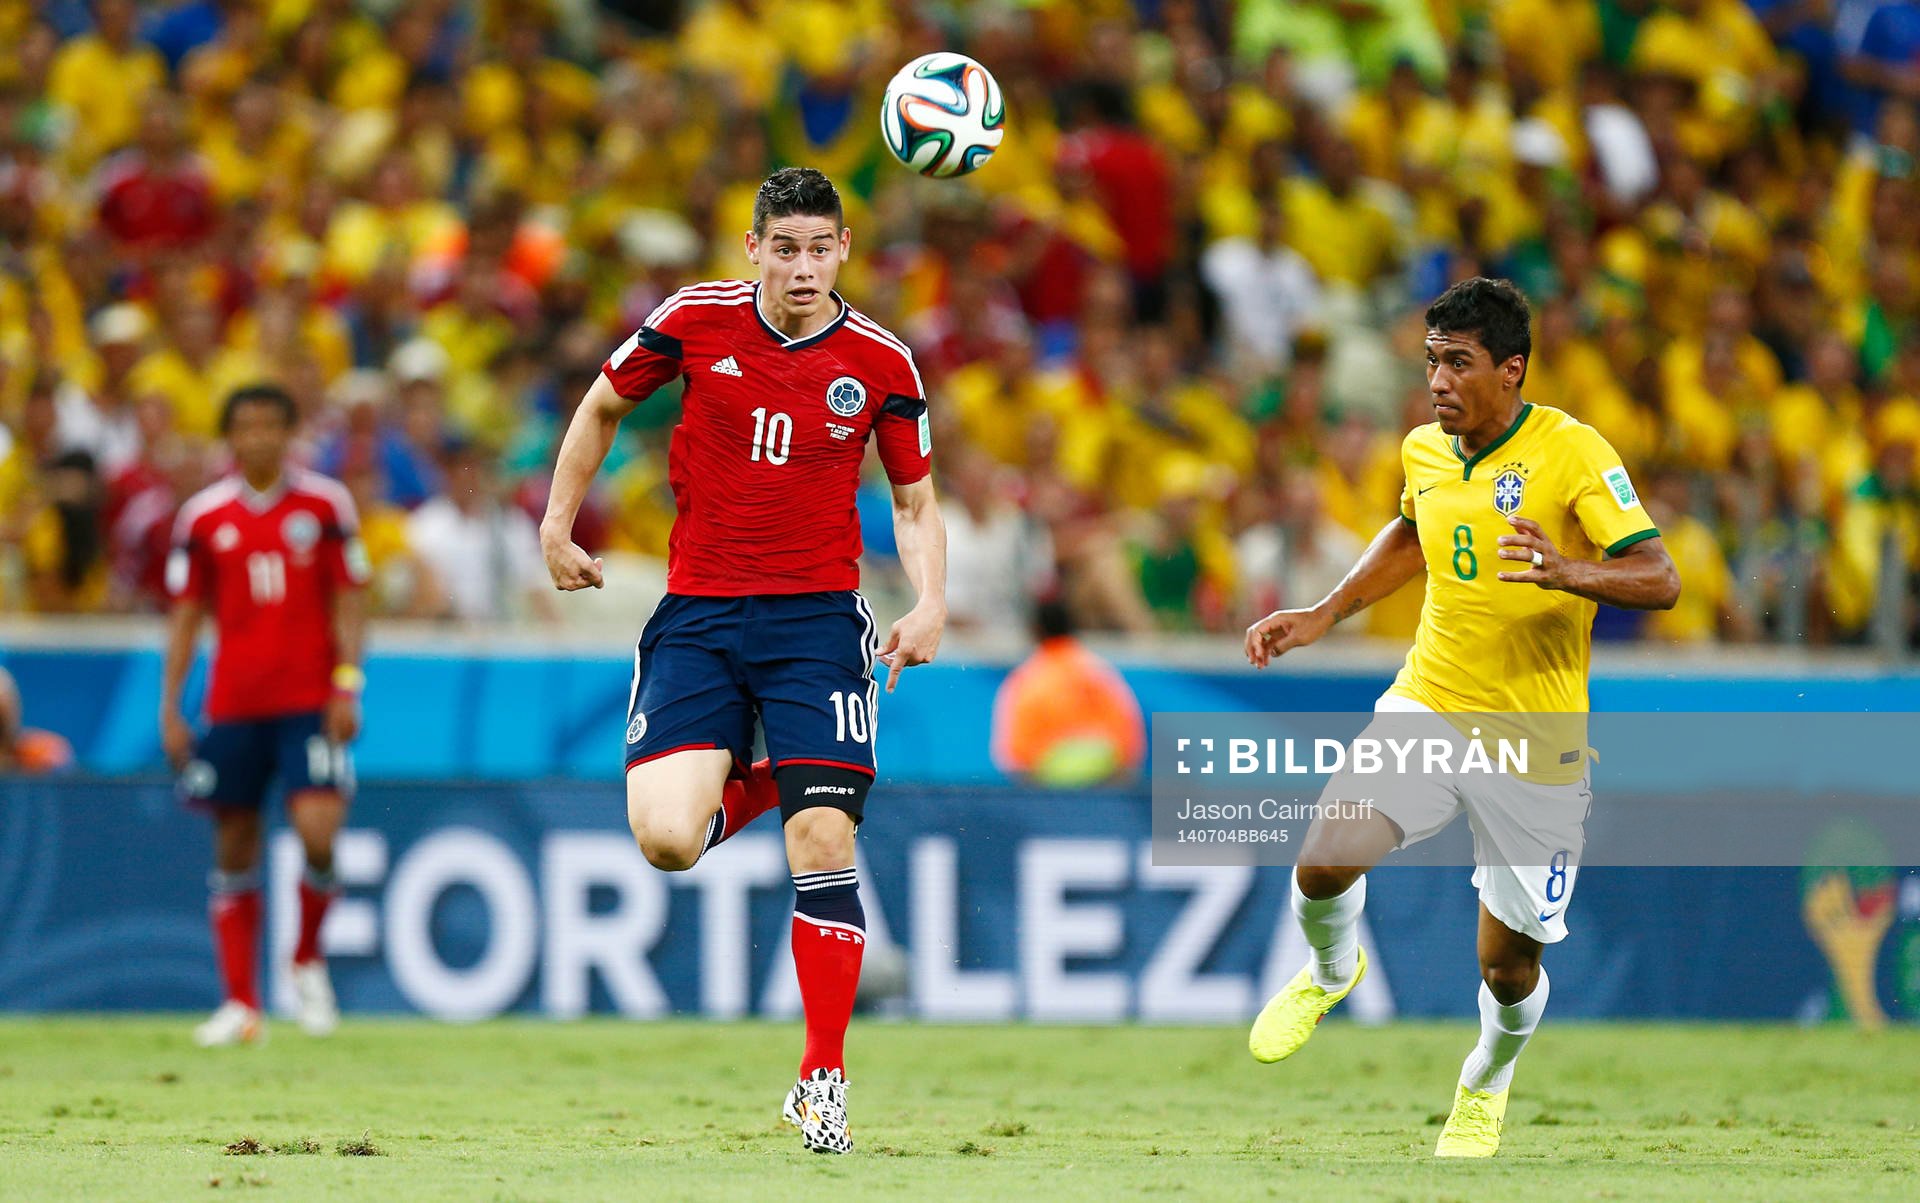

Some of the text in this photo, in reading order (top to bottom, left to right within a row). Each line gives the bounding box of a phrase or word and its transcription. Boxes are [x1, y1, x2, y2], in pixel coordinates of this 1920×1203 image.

[711, 364, 742, 377] adidas
[751, 407, 793, 466] 10
[1452, 525, 1477, 580] 8
[828, 691, 868, 743] 10
[804, 785, 847, 796] MERCUR
[1546, 850, 1568, 903] 8
